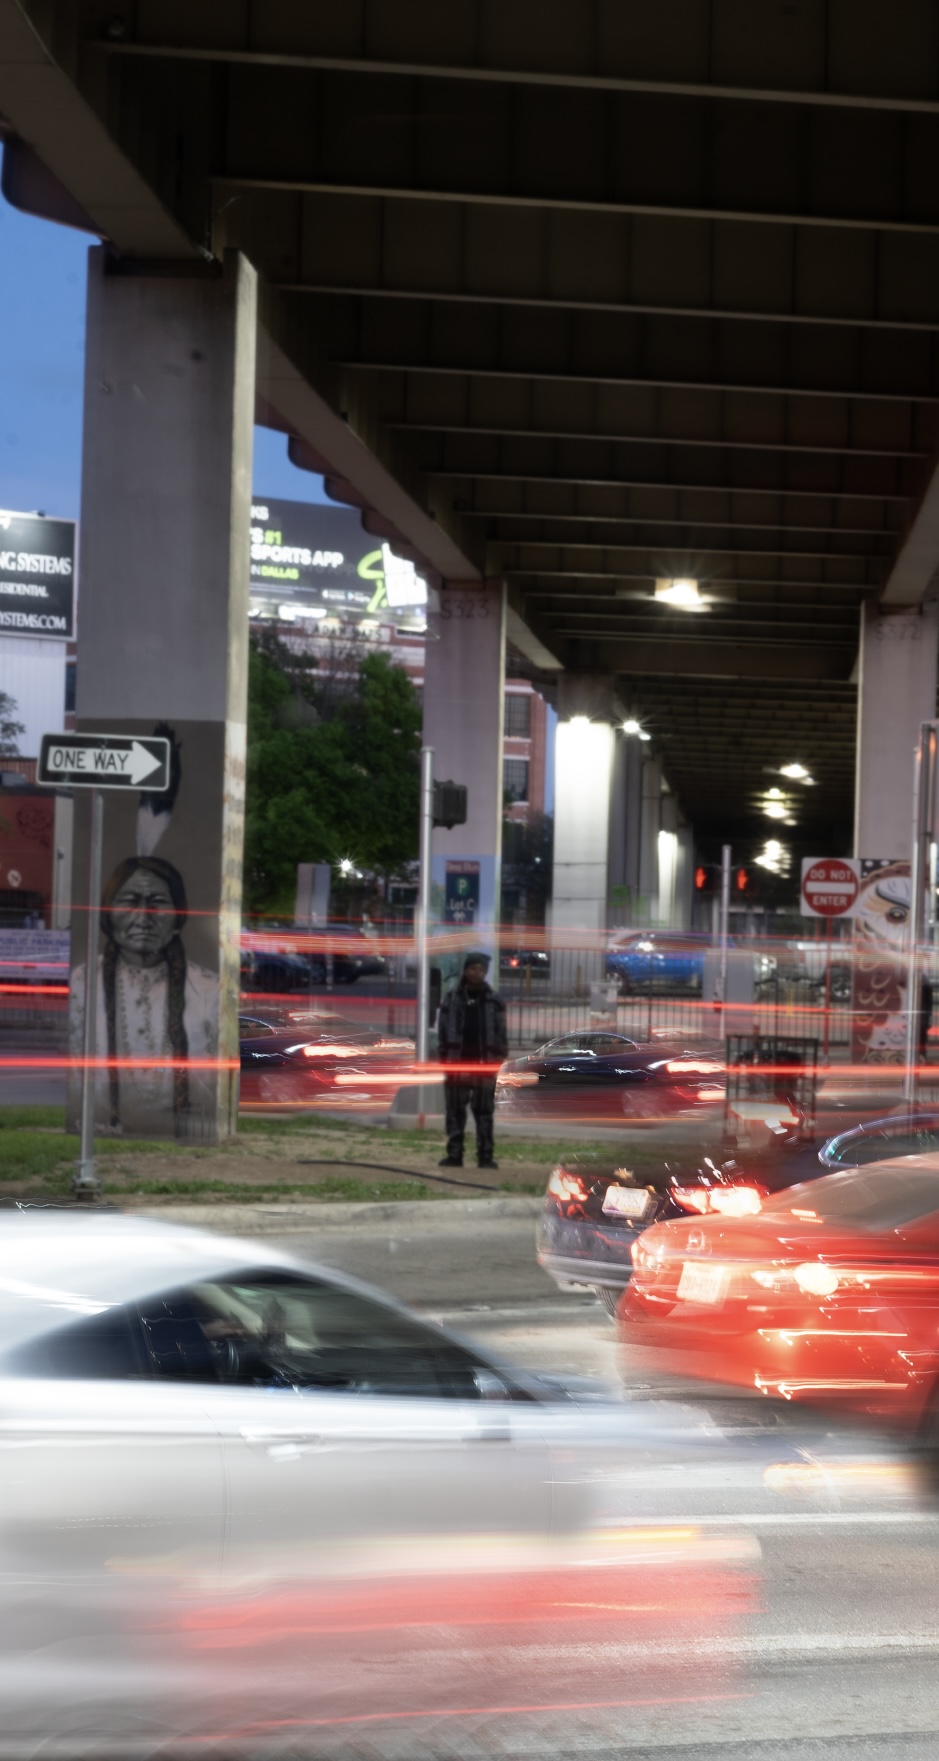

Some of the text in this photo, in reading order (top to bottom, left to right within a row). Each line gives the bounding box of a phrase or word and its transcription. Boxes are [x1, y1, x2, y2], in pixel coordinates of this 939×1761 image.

[264, 529, 282, 545] #1
[17, 552, 72, 575] SYSTEMS
[251, 543, 344, 568] SPORTS APP
[261, 565, 299, 580] DALLAS
[53, 749, 129, 772] ONE WAY
[810, 869, 852, 880] DO NOT
[459, 878, 467, 895] P
[450, 898, 474, 911] Lot C
[813, 895, 848, 907] ENTER
